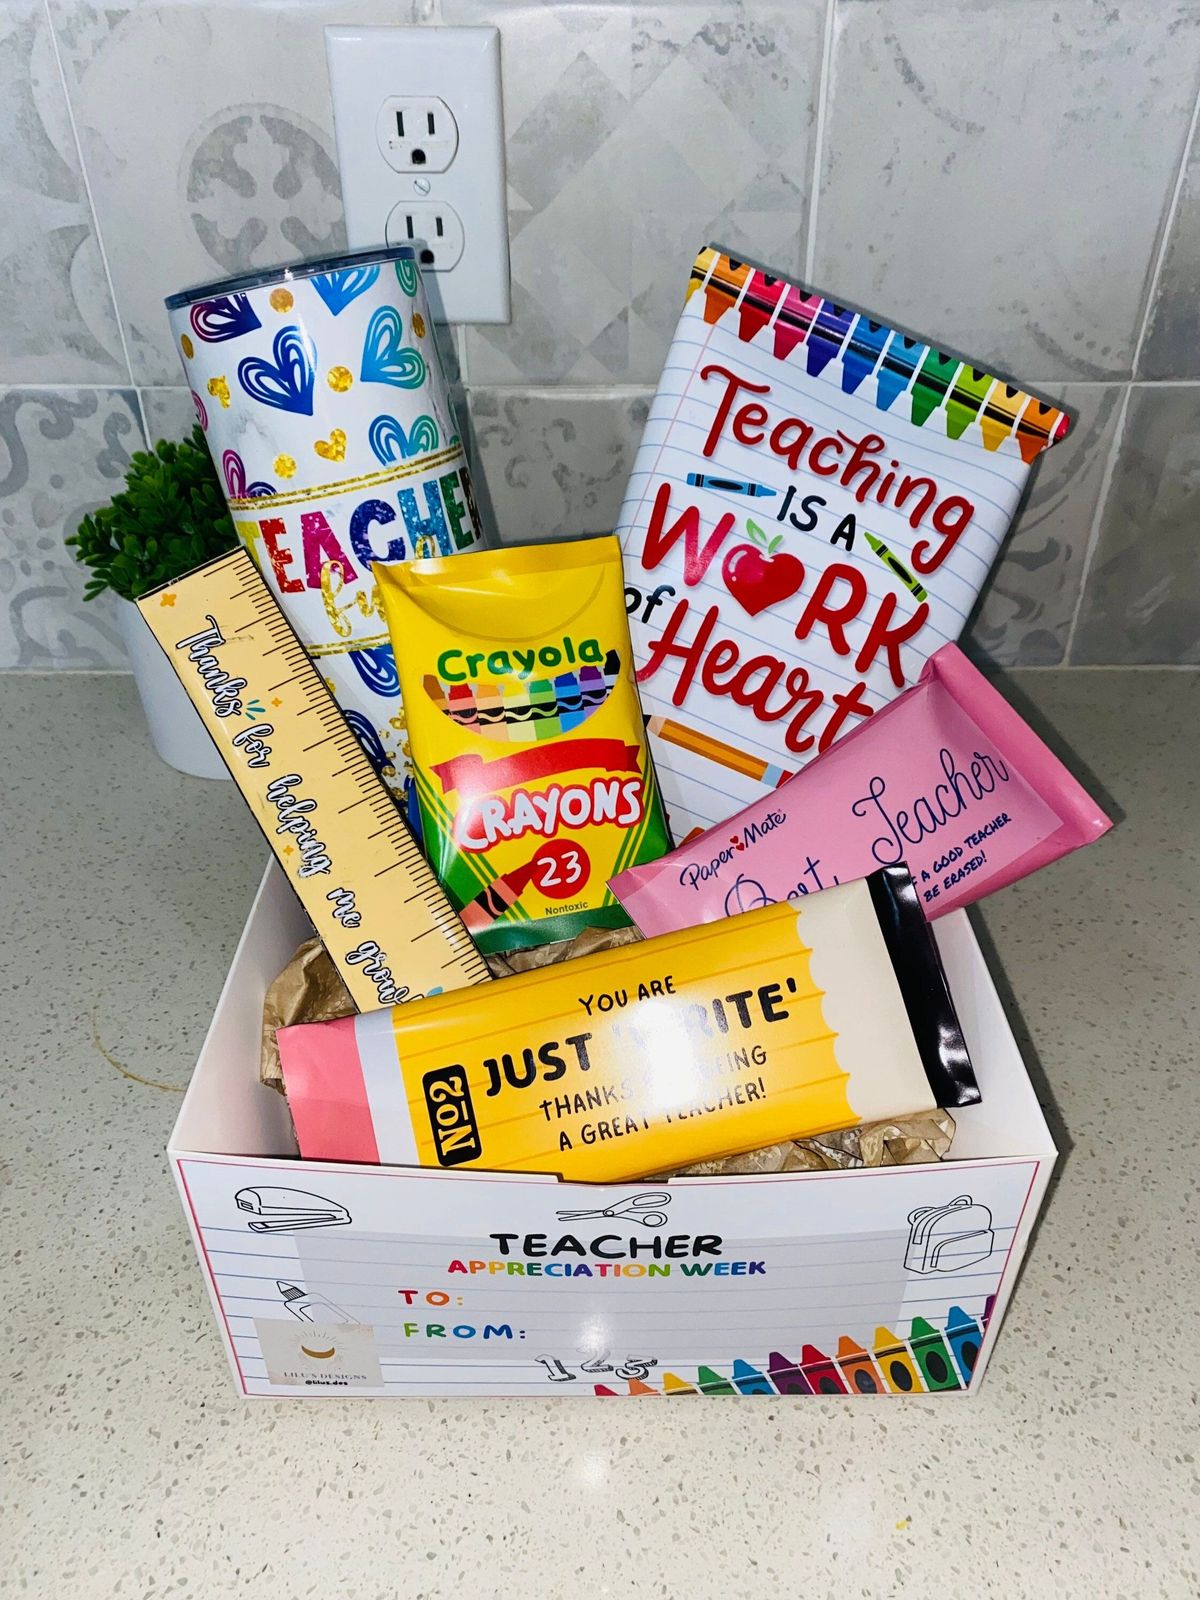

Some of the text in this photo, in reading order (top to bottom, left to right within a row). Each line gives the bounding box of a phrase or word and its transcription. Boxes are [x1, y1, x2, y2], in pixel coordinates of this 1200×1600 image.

[700, 364, 975, 574] Teaching
[776, 485, 857, 552] IS A
[624, 584, 676, 624] of
[437, 636, 604, 682] Crayola
[636, 598, 874, 754] Heart
[175, 614, 248, 719] Thanks
[232, 723, 275, 769] for
[266, 773, 333, 878] helping
[326, 886, 362, 929] me
[454, 778, 643, 853] CRAYONS
[851, 748, 1010, 866] Teacher
[537, 850, 582, 888] 23
[679, 846, 735, 891] Paper
[743, 812, 787, 849] Mate
[921, 812, 1012, 883] A GOOD TEACHER
[923, 849, 988, 903] BE ERASED!
[545, 900, 589, 916] Nontoxic
[578, 975, 676, 1017] YOU ARE
[482, 1032, 593, 1097] JUST
[558, 1130, 573, 1151] A
[447, 1260, 767, 1278] APPRECIATION WEEK
[489, 1233, 723, 1259] TEACHER
[398, 1290, 464, 1307] TO:
[403, 1322, 527, 1341] FROM:
